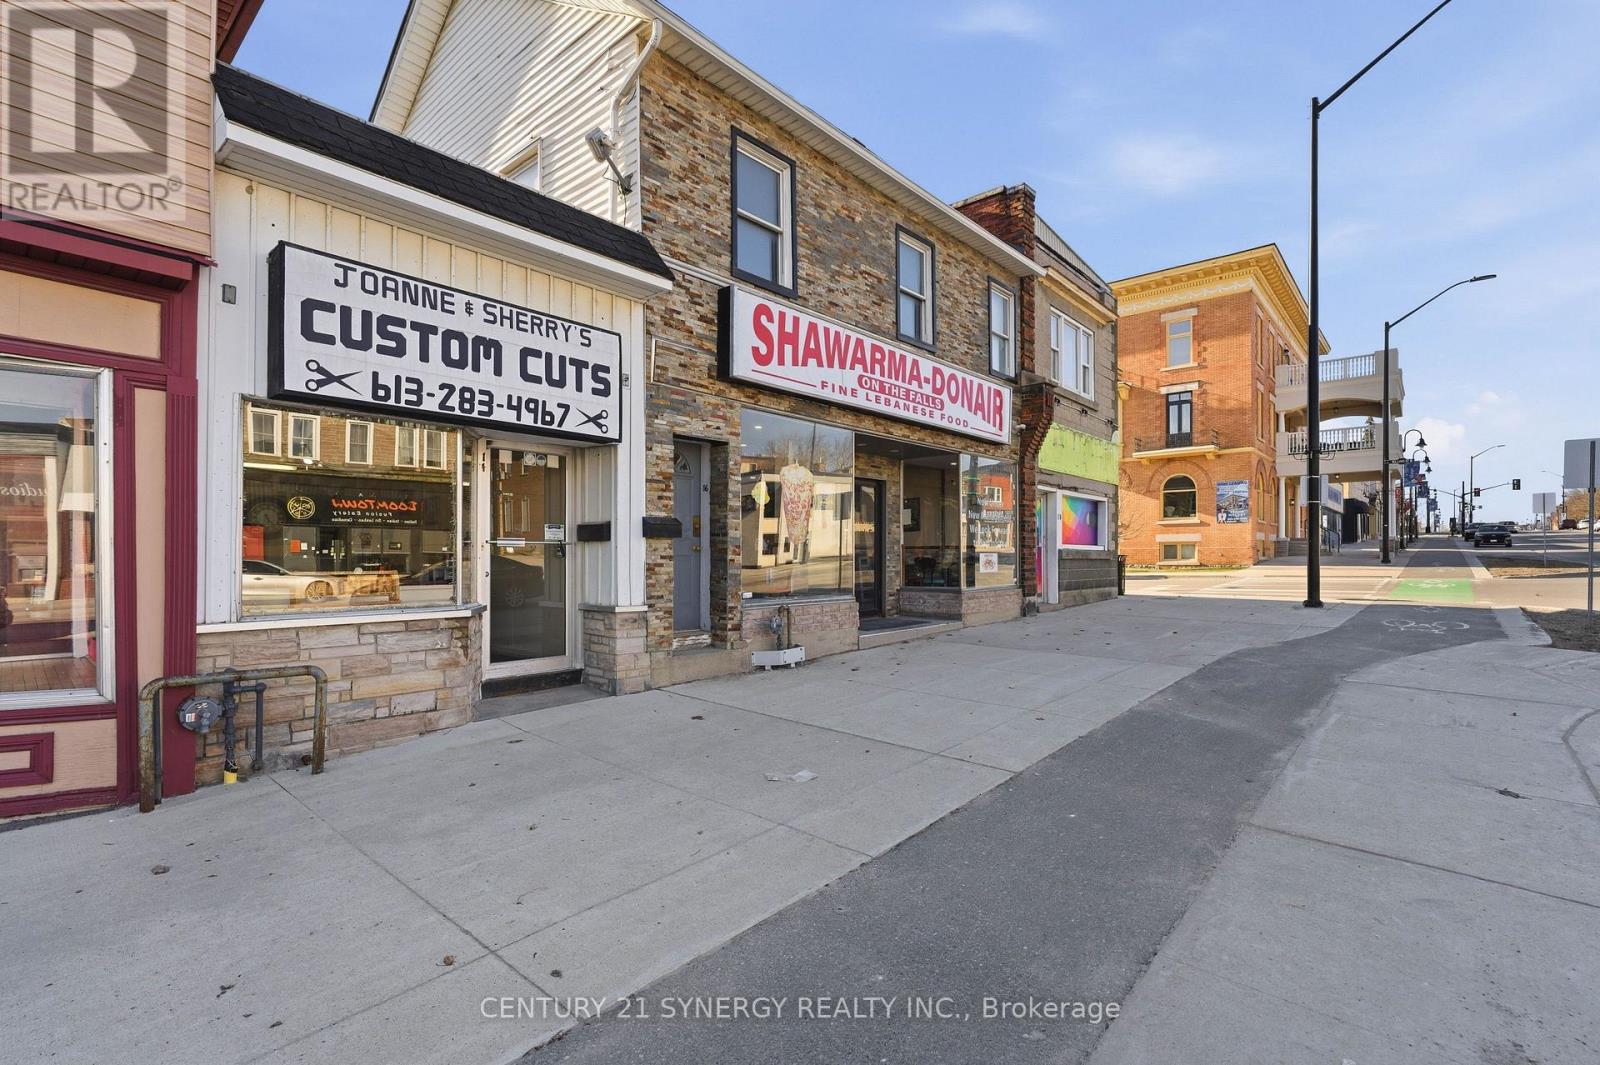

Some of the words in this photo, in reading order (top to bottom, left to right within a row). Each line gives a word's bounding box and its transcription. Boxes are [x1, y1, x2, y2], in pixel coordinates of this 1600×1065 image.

[333, 262, 456, 316] JOANNE
[464, 299, 474, 317] &
[482, 302, 592, 348] SHERRY'S
[300, 297, 503, 378] CUSTOM
[519, 346, 612, 398] CUTS
[751, 303, 1005, 432] SHAWARMA-DONAIR
[371, 370, 571, 428] 613-283-4967
[820, 380, 858, 398] FINE
[865, 391, 935, 419] LEBANESE
[940, 413, 969, 428] FOOD
[862, 376, 880, 392] ON
[884, 382, 907, 401] THE
[909, 391, 942, 409] FALLS
